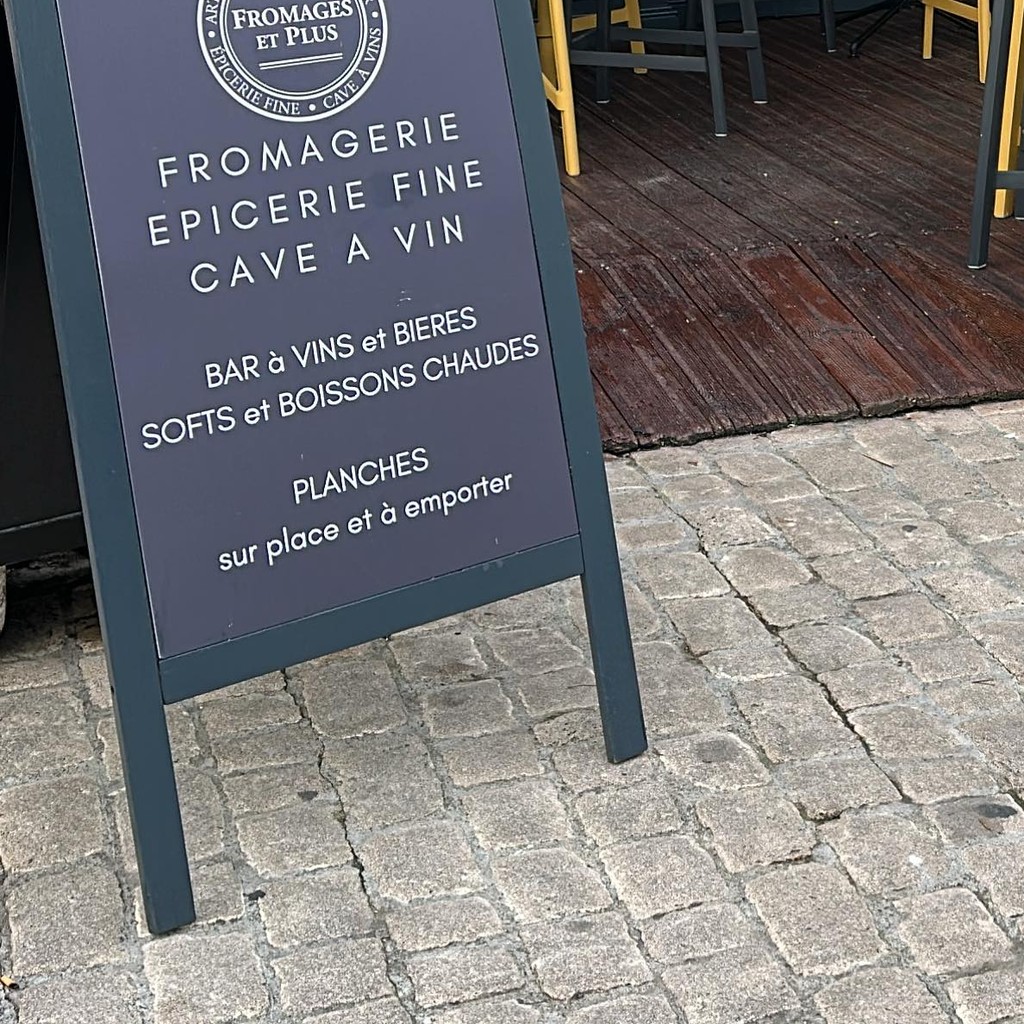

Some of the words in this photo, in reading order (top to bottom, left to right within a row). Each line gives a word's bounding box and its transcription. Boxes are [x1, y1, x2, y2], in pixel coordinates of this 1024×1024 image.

[255, 33, 279, 50] ET
[284, 24, 339, 46] PLUS
[322, 80, 359, 109] CAVE
[355, 68, 370, 82] À
[363, 27, 382, 63] VINS
[209, 45, 263, 105] ÉPICERIE
[263, 97, 300, 115] FINE
[158, 113, 460, 188] FROMAGERIE
[148, 181, 366, 247] EPICERIE
[392, 160, 483, 202] FINE
[191, 242, 318, 293] CAVE
[348, 233, 370, 265] A
[394, 215, 464, 254] VIN
[206, 355, 261, 389] BAR
[268, 350, 286, 374] à
[291, 334, 355, 368] VINS
[361, 328, 387, 353] et
[394, 307, 477, 346] BIERES
[141, 405, 236, 449] SOFTS
[245, 399, 271, 425] et
[279, 363, 417, 418] BOISSONS
[423, 334, 540, 381] CHAUDES
[293, 448, 429, 505] PLANCHES
[220, 545, 258, 571] sur
[267, 526, 340, 566] place
[348, 508, 373, 534] et
[380, 501, 397, 525] à
[405, 474, 513, 518] emporter
